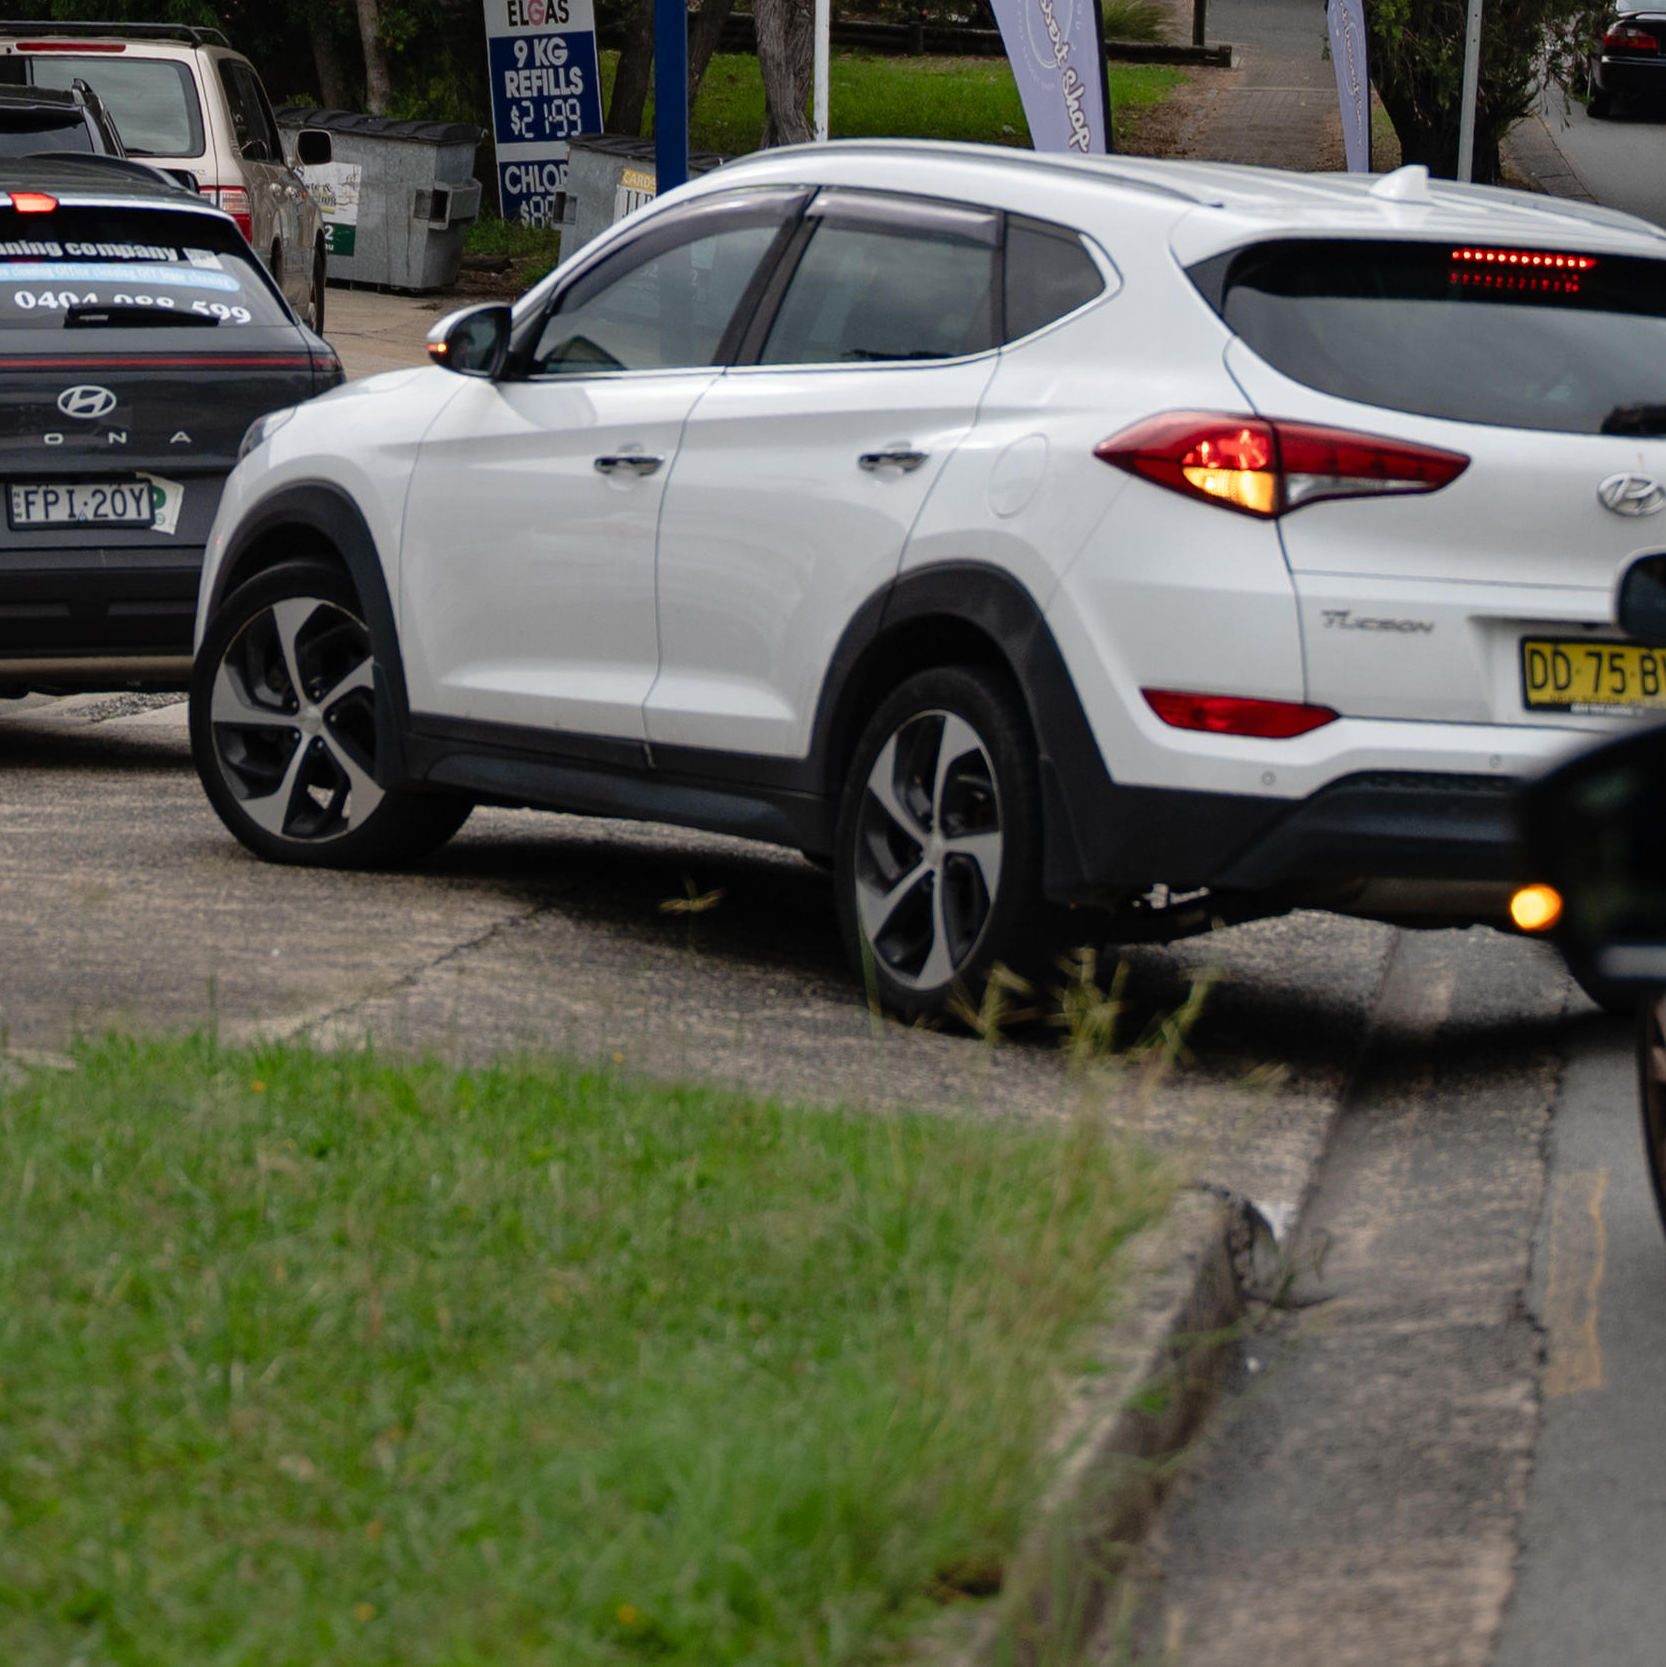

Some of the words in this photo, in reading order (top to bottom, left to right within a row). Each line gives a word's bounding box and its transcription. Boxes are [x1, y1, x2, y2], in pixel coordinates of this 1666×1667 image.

[513, 39, 529, 69] 9
[533, 37, 569, 68] KG
[504, 66, 584, 99] REFILLS
[1062, 66, 1091, 154] Shop
[65, 241, 179, 263] company
